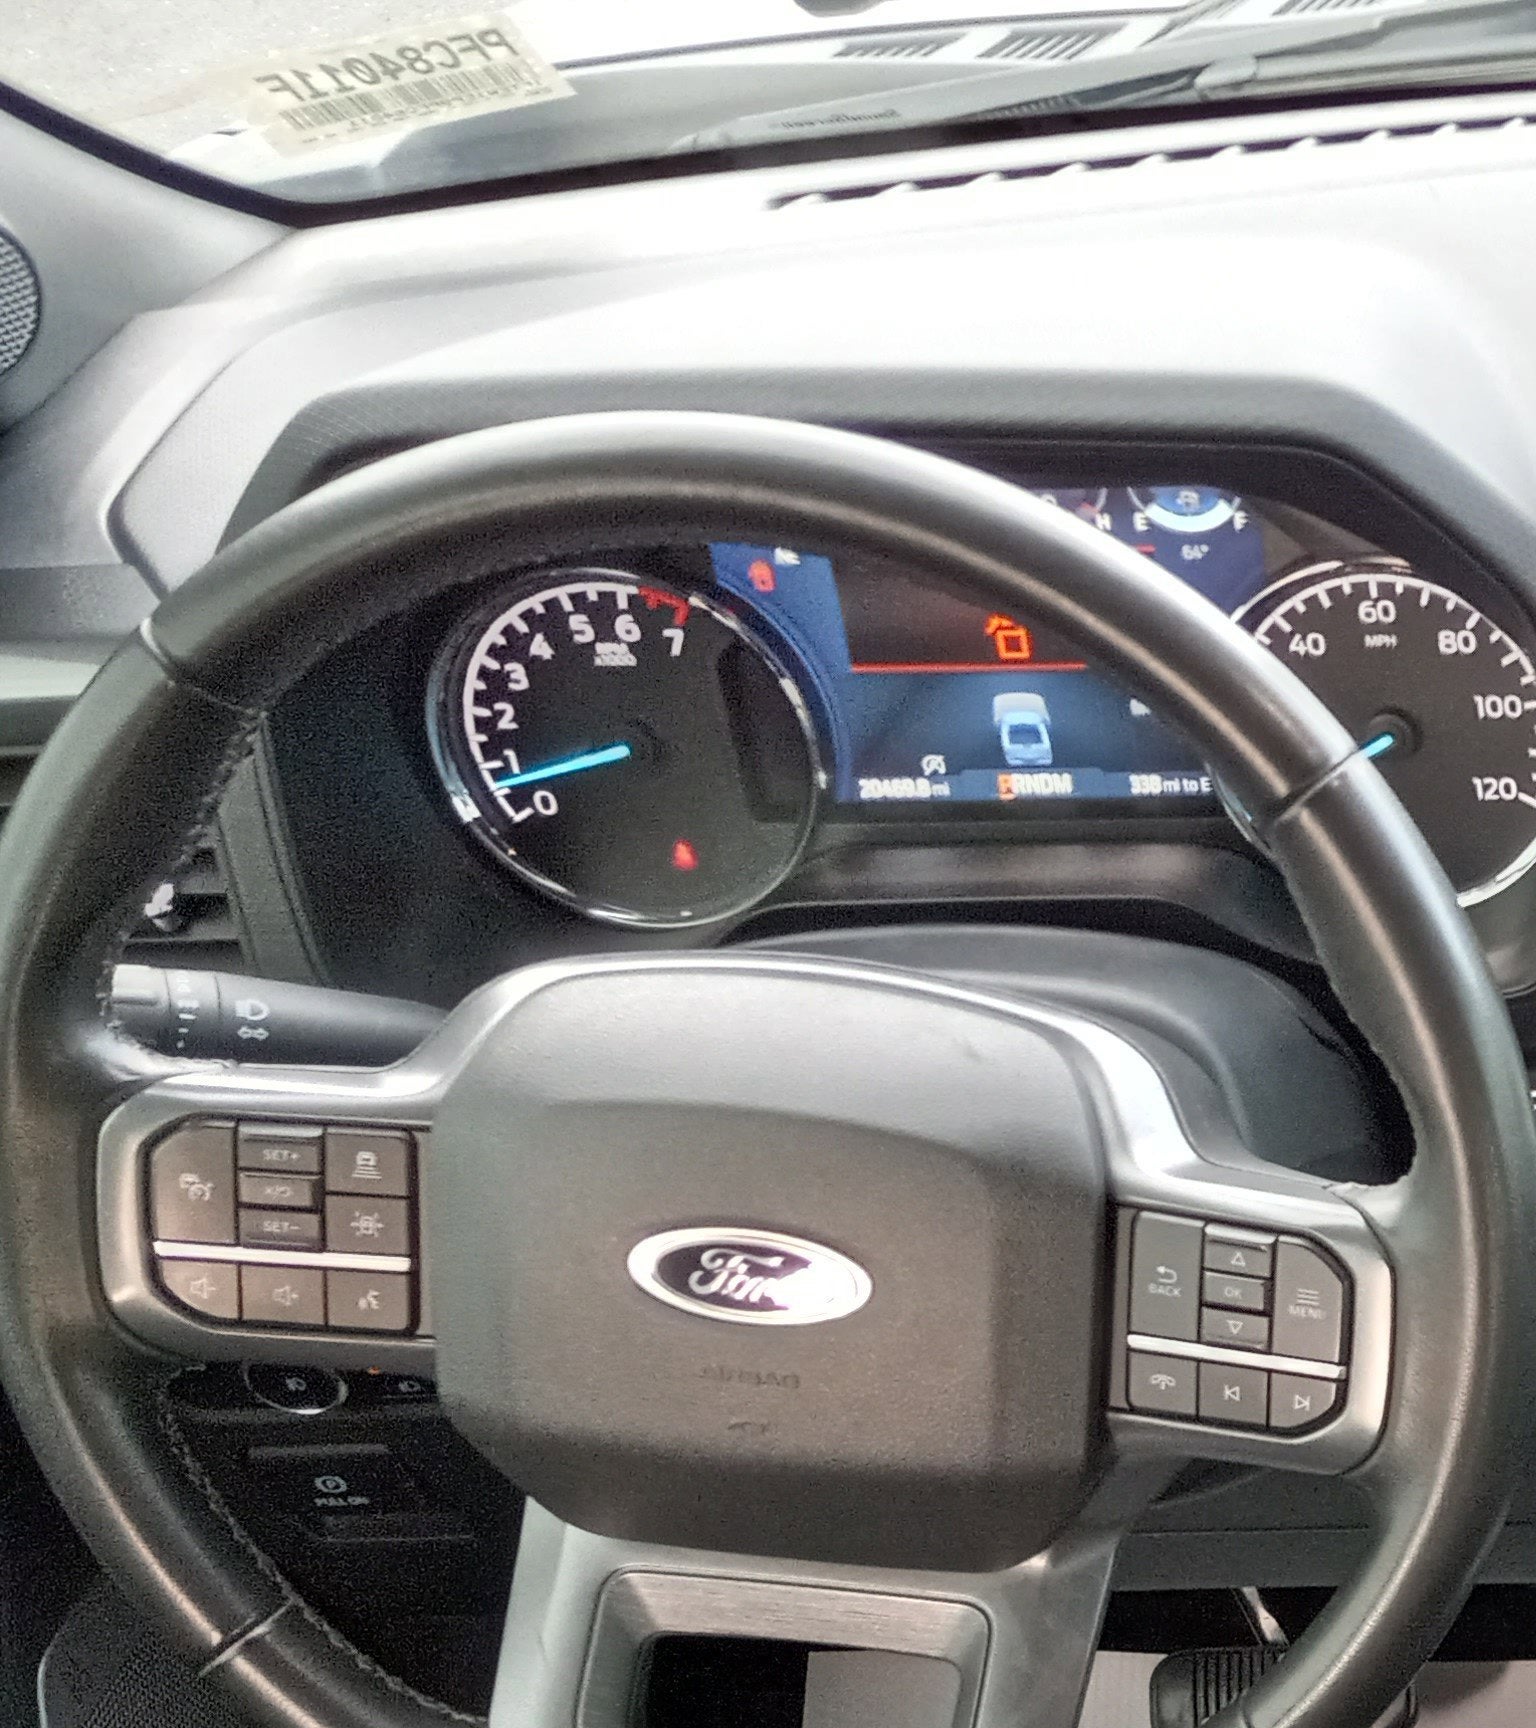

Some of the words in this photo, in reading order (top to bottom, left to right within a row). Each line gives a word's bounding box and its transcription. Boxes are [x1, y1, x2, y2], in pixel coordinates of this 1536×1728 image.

[1133, 511, 1149, 532] E
[1233, 511, 1249, 532] F
[1358, 600, 1396, 624] 60
[571, 615, 595, 643] 5
[615, 615, 641, 642] 6
[1364, 633, 1398, 649] MPH
[530, 633, 554, 661] 4
[663, 626, 685, 657] 7
[1289, 632, 1326, 656] 40
[1437, 630, 1477, 655] 80
[503, 662, 529, 690] 3
[494, 703, 517, 731] 2
[1473, 694, 1523, 719] 100
[502, 749, 522, 775] 1
[1182, 777, 1199, 793] to
[1472, 776, 1518, 801] 120
[533, 790, 558, 816] 0
[1148, 1284, 1182, 1298] BACK
[1223, 1286, 1243, 1300] OK
[1288, 1305, 1326, 1321] MENU
